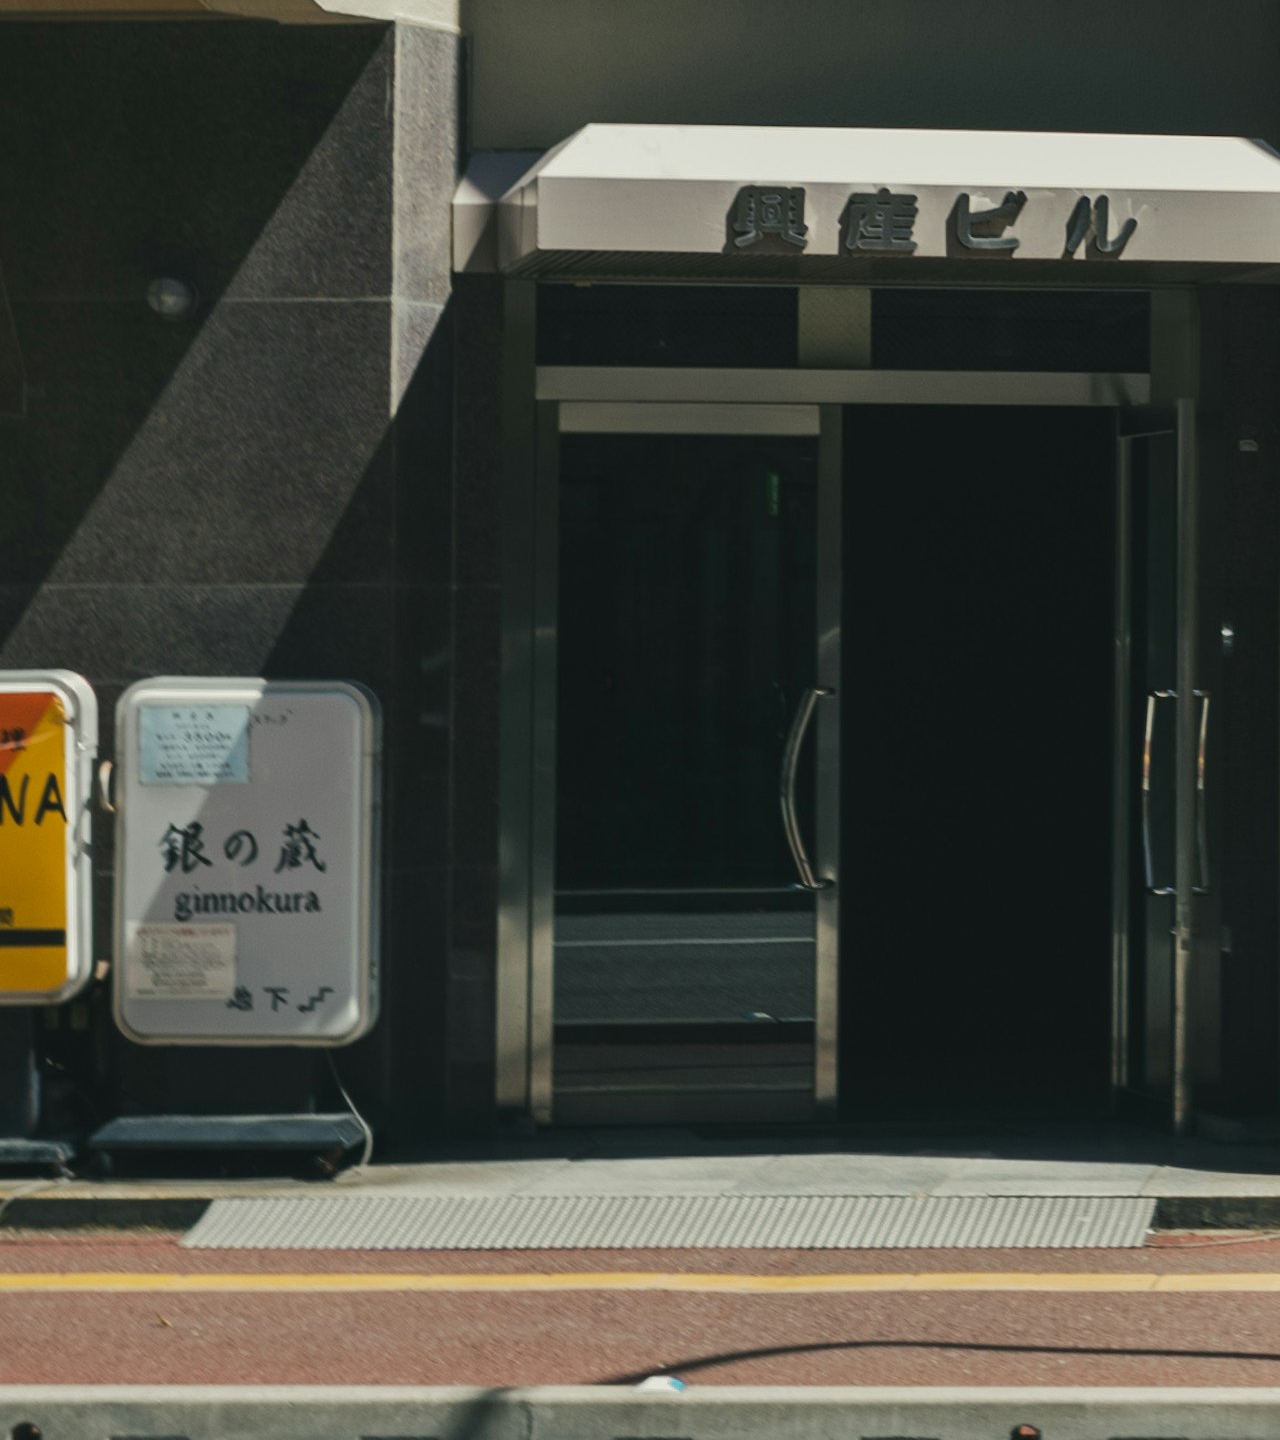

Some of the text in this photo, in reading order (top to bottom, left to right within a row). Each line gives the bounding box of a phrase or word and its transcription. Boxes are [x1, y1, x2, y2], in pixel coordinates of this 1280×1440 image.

[732, 184, 1138, 253] 興産ビル
[158, 817, 327, 875] 銀の蔵
[174, 884, 322, 923] ginnokura
